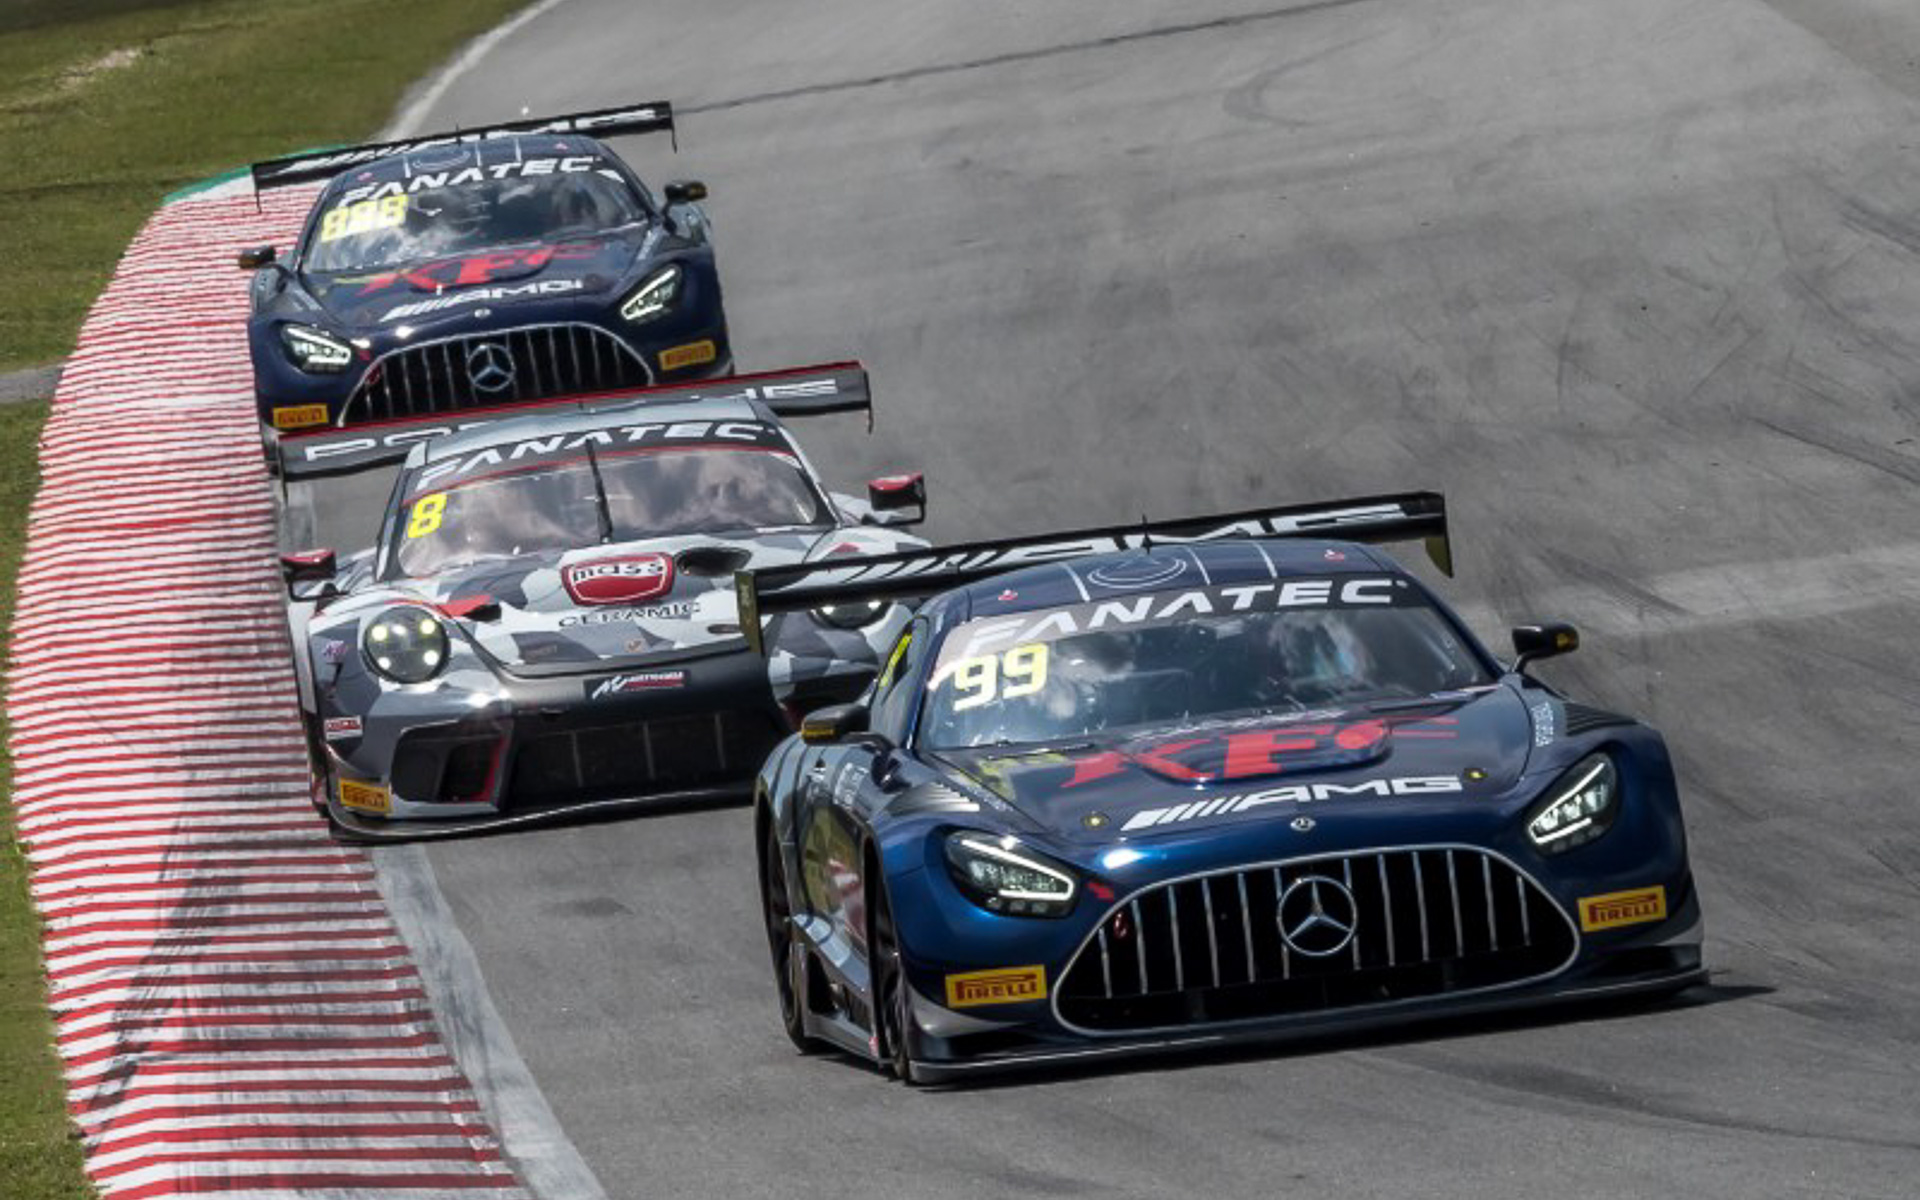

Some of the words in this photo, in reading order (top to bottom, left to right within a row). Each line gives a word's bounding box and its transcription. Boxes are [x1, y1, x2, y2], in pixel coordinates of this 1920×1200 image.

[339, 156, 594, 208] FANATEC
[415, 422, 764, 492] FANATEC
[408, 493, 447, 538] 8
[573, 563, 664, 582] mass
[963, 579, 1395, 658] FANATEC
[953, 642, 1050, 711] 99
[1588, 892, 1657, 924] PIRELLI
[955, 973, 1038, 1000] PIRELLI
